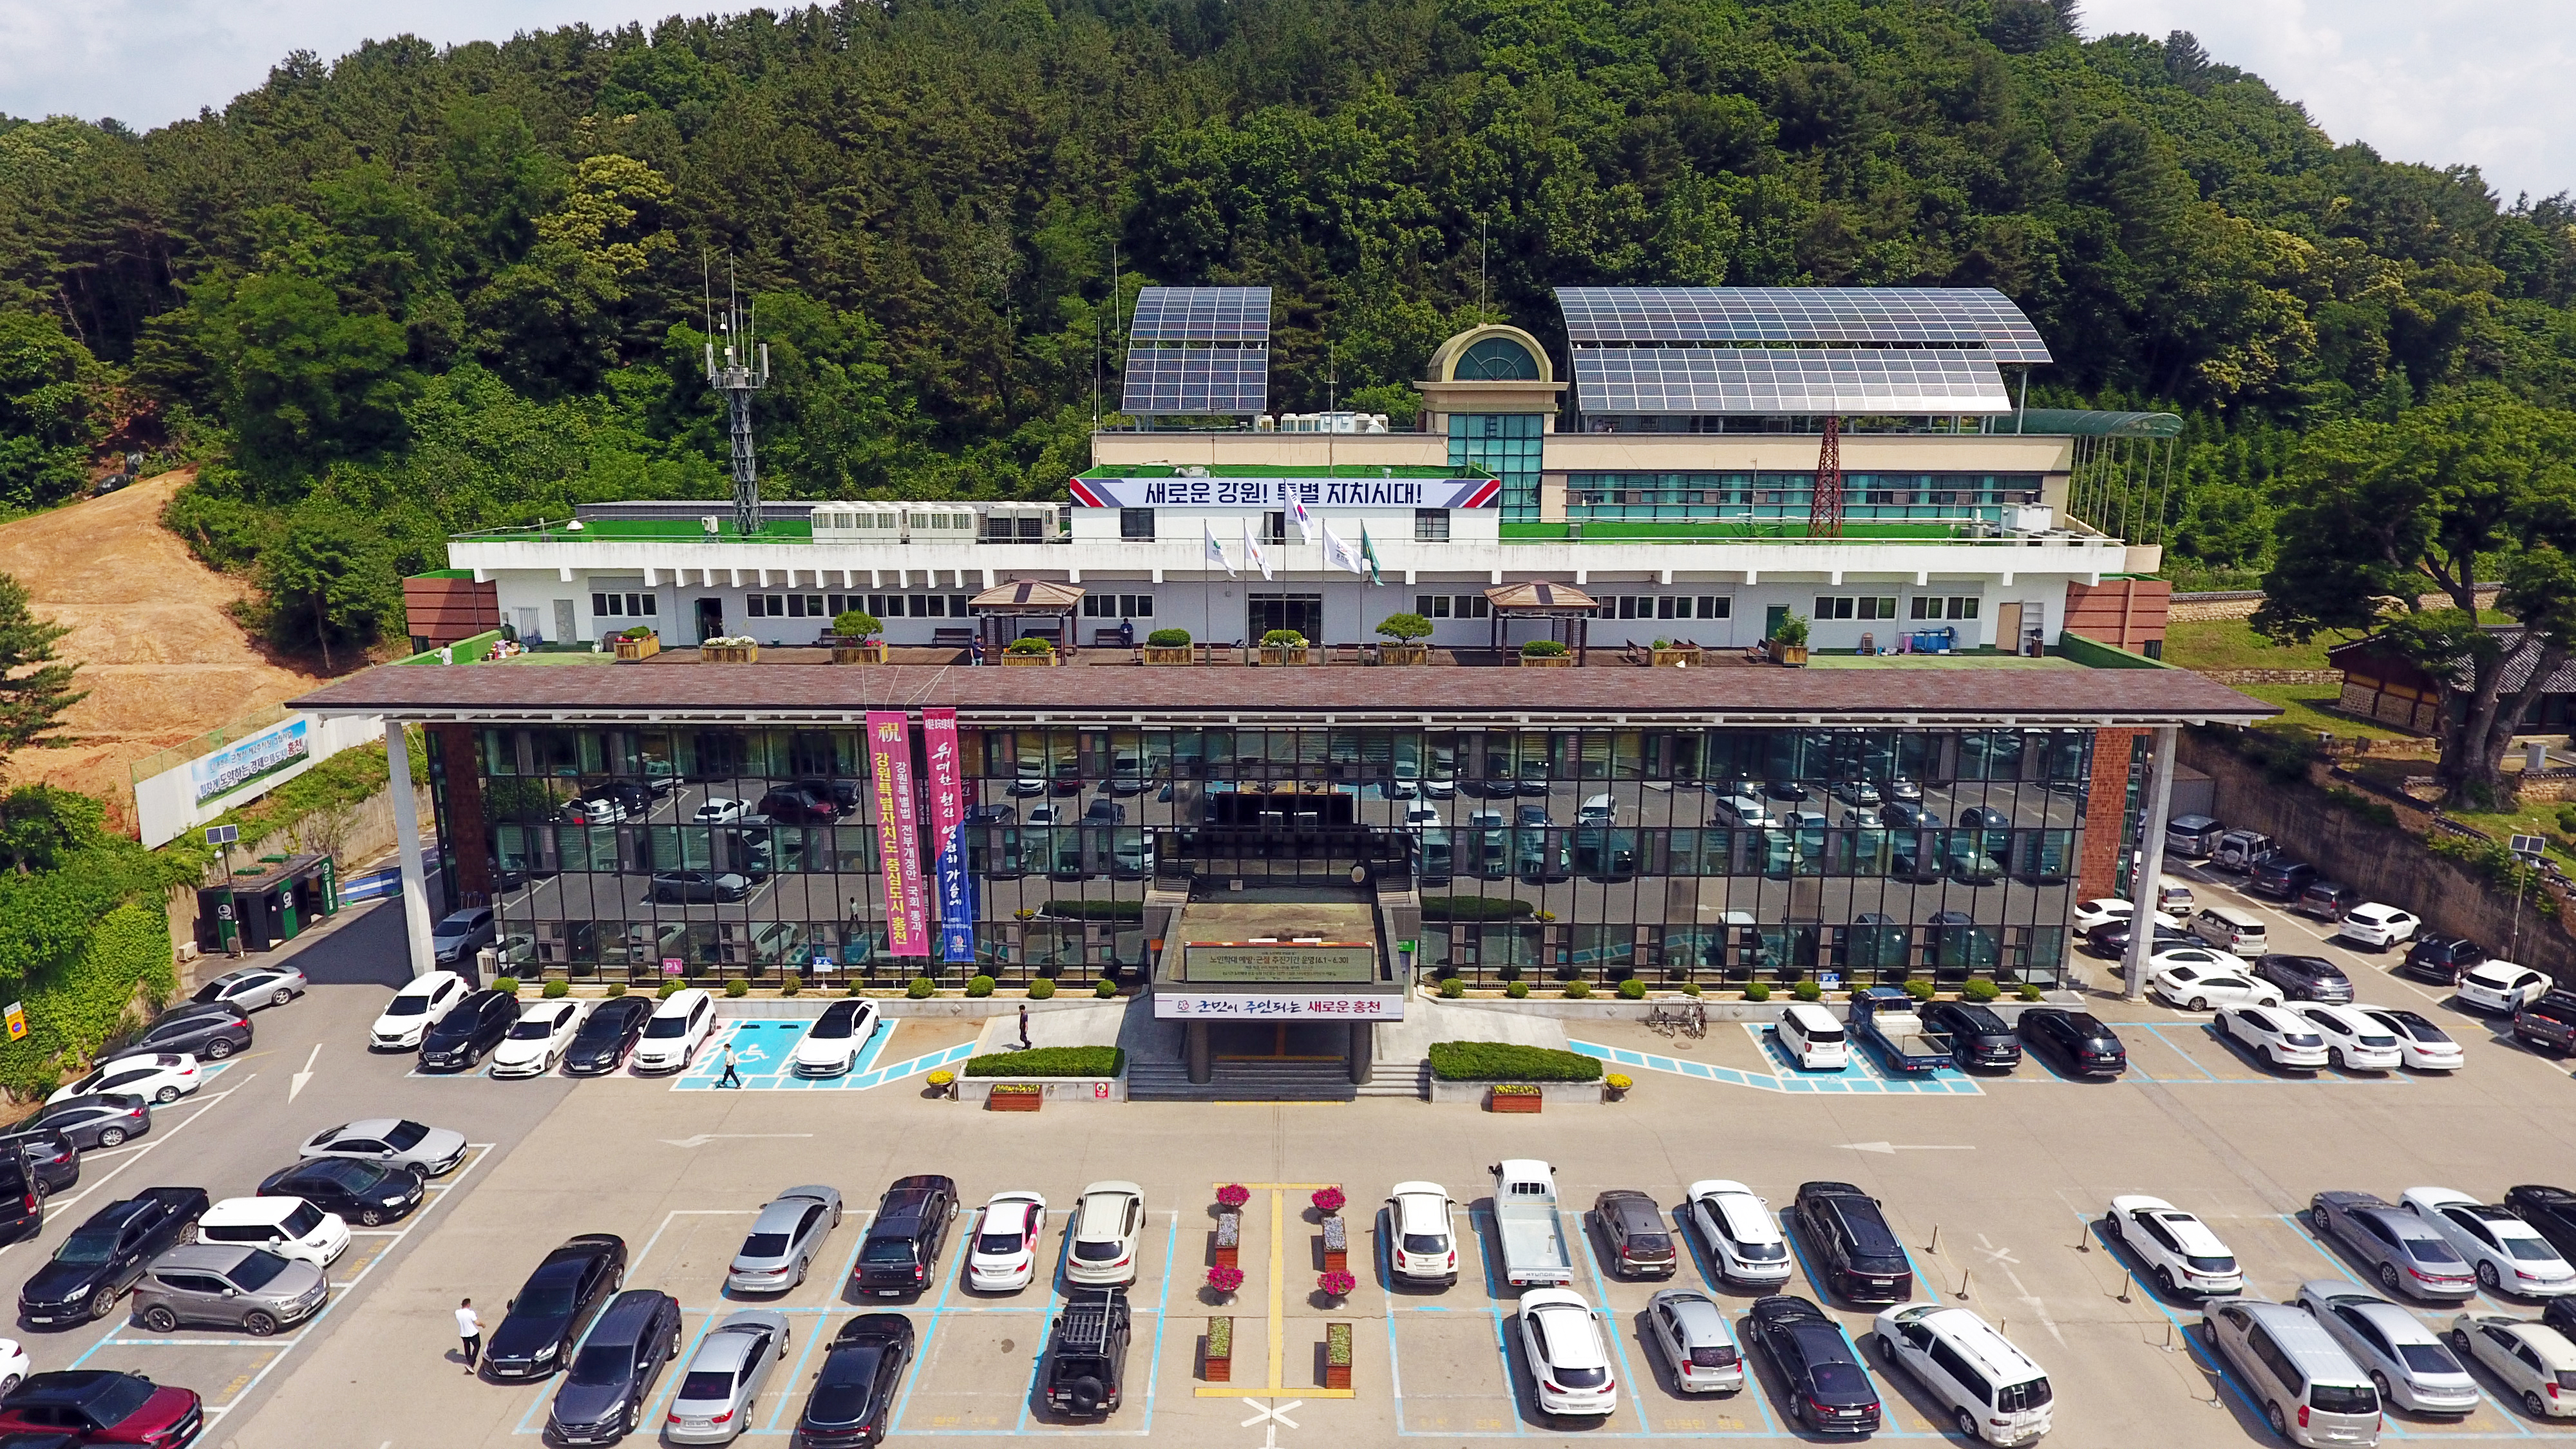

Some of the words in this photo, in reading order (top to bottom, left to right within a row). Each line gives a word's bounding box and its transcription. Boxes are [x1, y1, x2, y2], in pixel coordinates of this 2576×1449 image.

[1145, 482, 1210, 504] 새로운
[1217, 482, 1268, 504] 강원!
[1327, 482, 1422, 504] 자치시대!
[878, 722, 902, 742] 祝
[200, 778, 220, 795] 힘차게
[220, 765, 250, 785] 도약하는
[288, 738, 304, 755] 홍천
[931, 741, 956, 786] 위대한
[875, 752, 899, 853] 강원특별자치도
[895, 761, 911, 819] 강원특별법
[939, 791, 954, 818] 헌신
[902, 824, 917, 881] 전부개정안
[942, 824, 958, 864] 영원히
[886, 858, 905, 914] 중심도시
[907, 886, 920, 908] 국회
[945, 869, 962, 906] 가슴에
[892, 916, 907, 945] 홍천
[909, 910, 922, 941] 통과!
[1271, 956, 1300, 964] 추진기간
[1195, 1000, 1238, 1014] 군민이
[1243, 999, 1302, 1014] 주인되는
[1307, 1000, 1350, 1014] 새로운
[1352, 1000, 1381, 1014] 홍천
